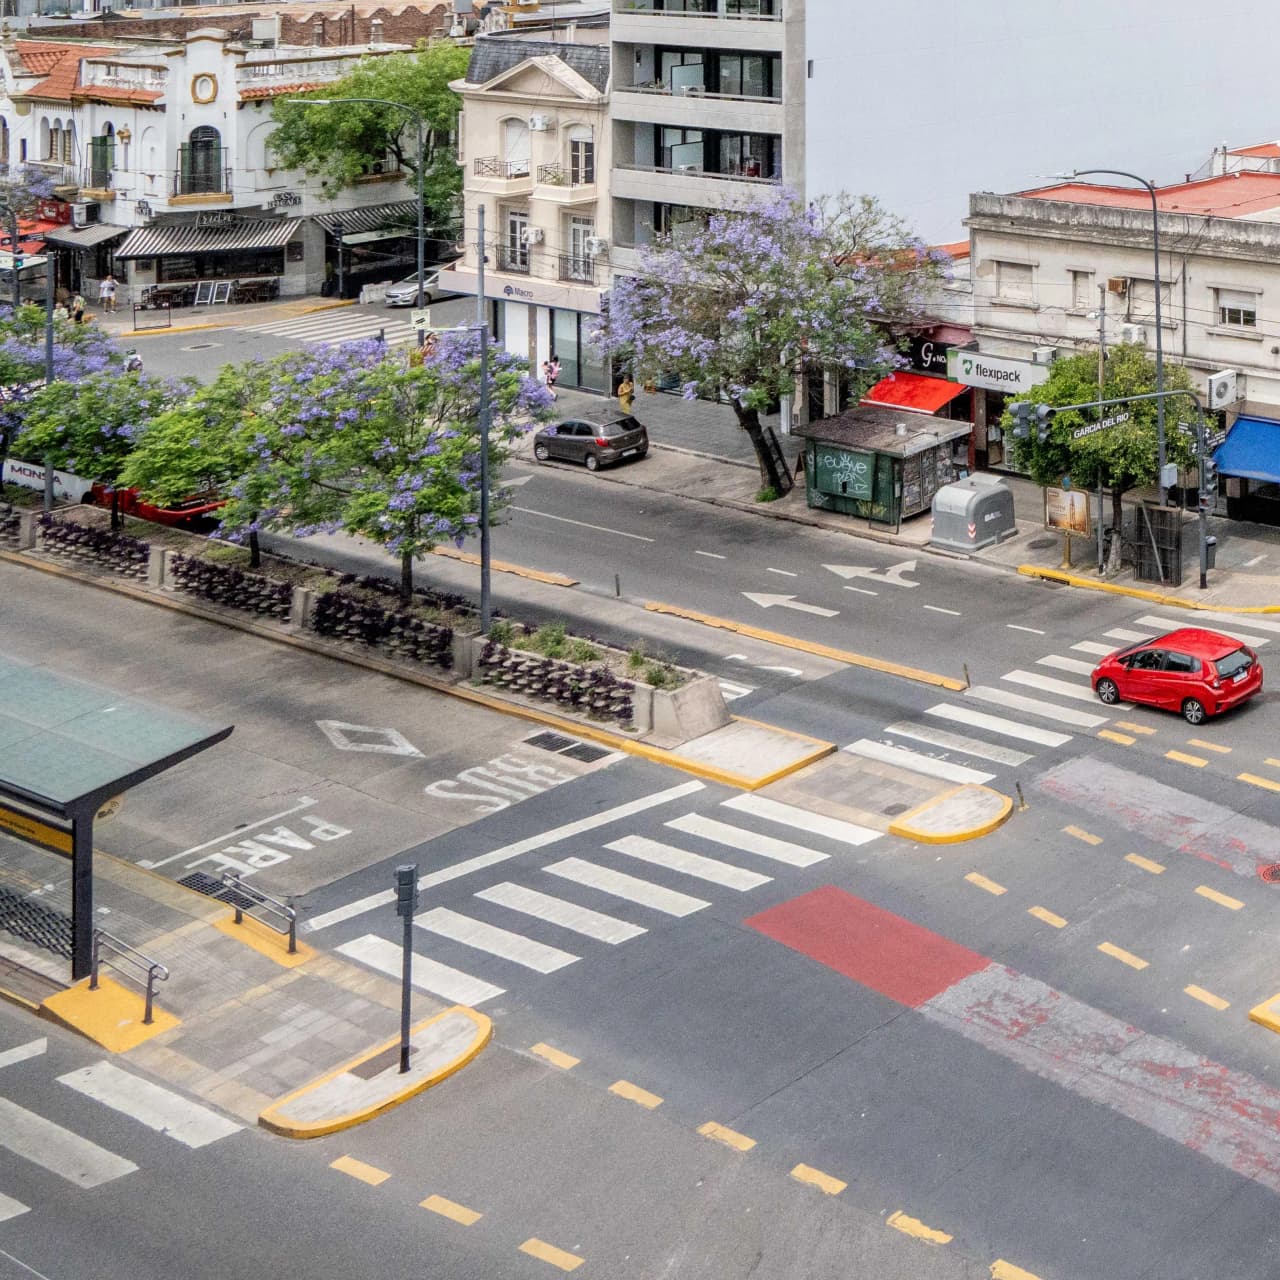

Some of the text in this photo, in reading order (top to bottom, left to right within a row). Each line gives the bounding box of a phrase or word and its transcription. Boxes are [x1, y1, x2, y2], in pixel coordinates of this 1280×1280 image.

[515, 287, 533, 297] Macro
[976, 364, 1021, 382] flexipack
[1074, 413, 1129, 439] GARCIA DEL RIO
[185, 815, 352, 879] PARE
